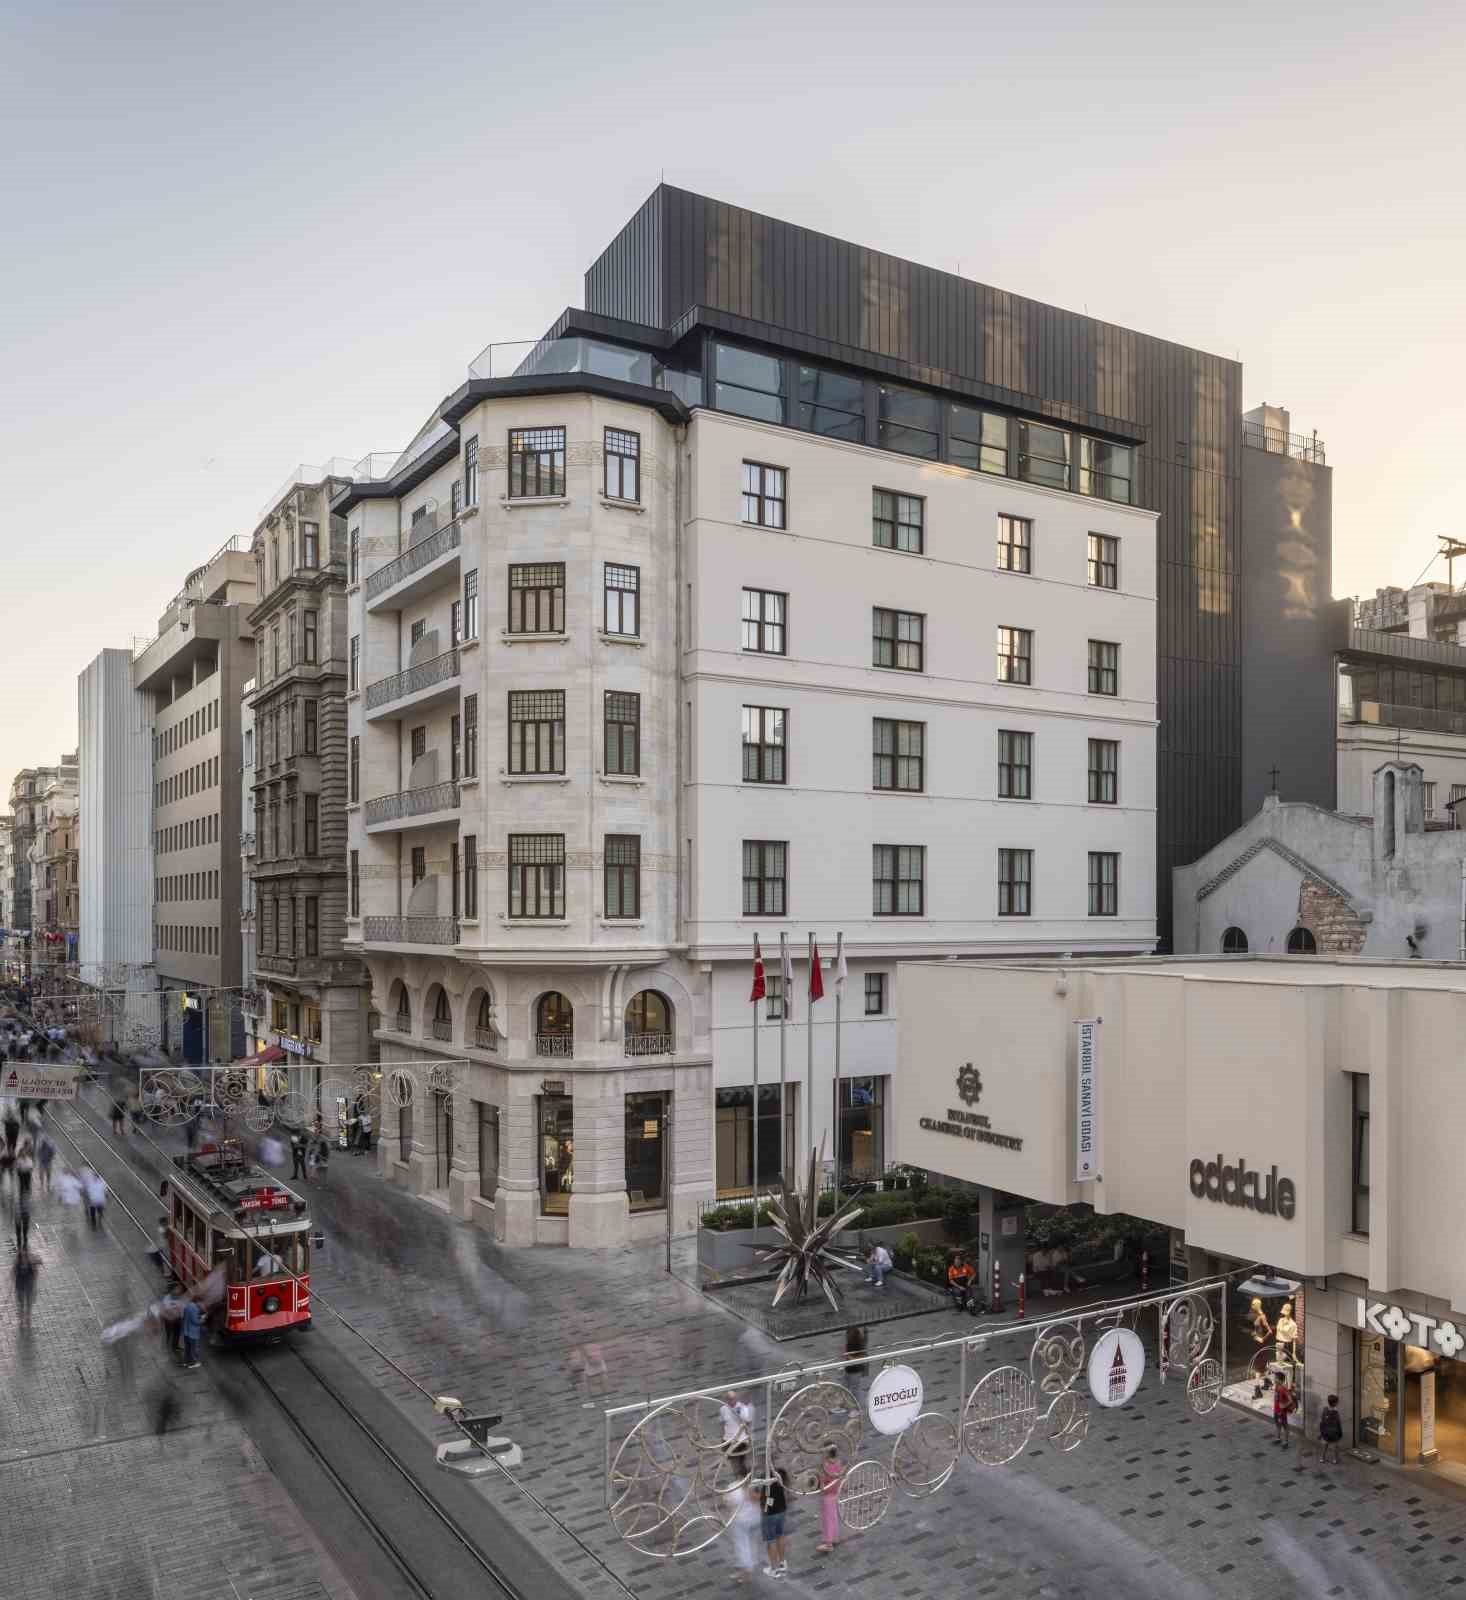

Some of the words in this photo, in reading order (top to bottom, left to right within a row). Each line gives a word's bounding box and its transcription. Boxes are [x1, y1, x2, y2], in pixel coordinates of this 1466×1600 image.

[1081, 1024, 1093, 1076] İSTANBUL
[1081, 1078, 1095, 1117] SANAYİ
[1081, 1120, 1091, 1152] ODASI
[873, 1387, 918, 1407] BEYOĞLU
